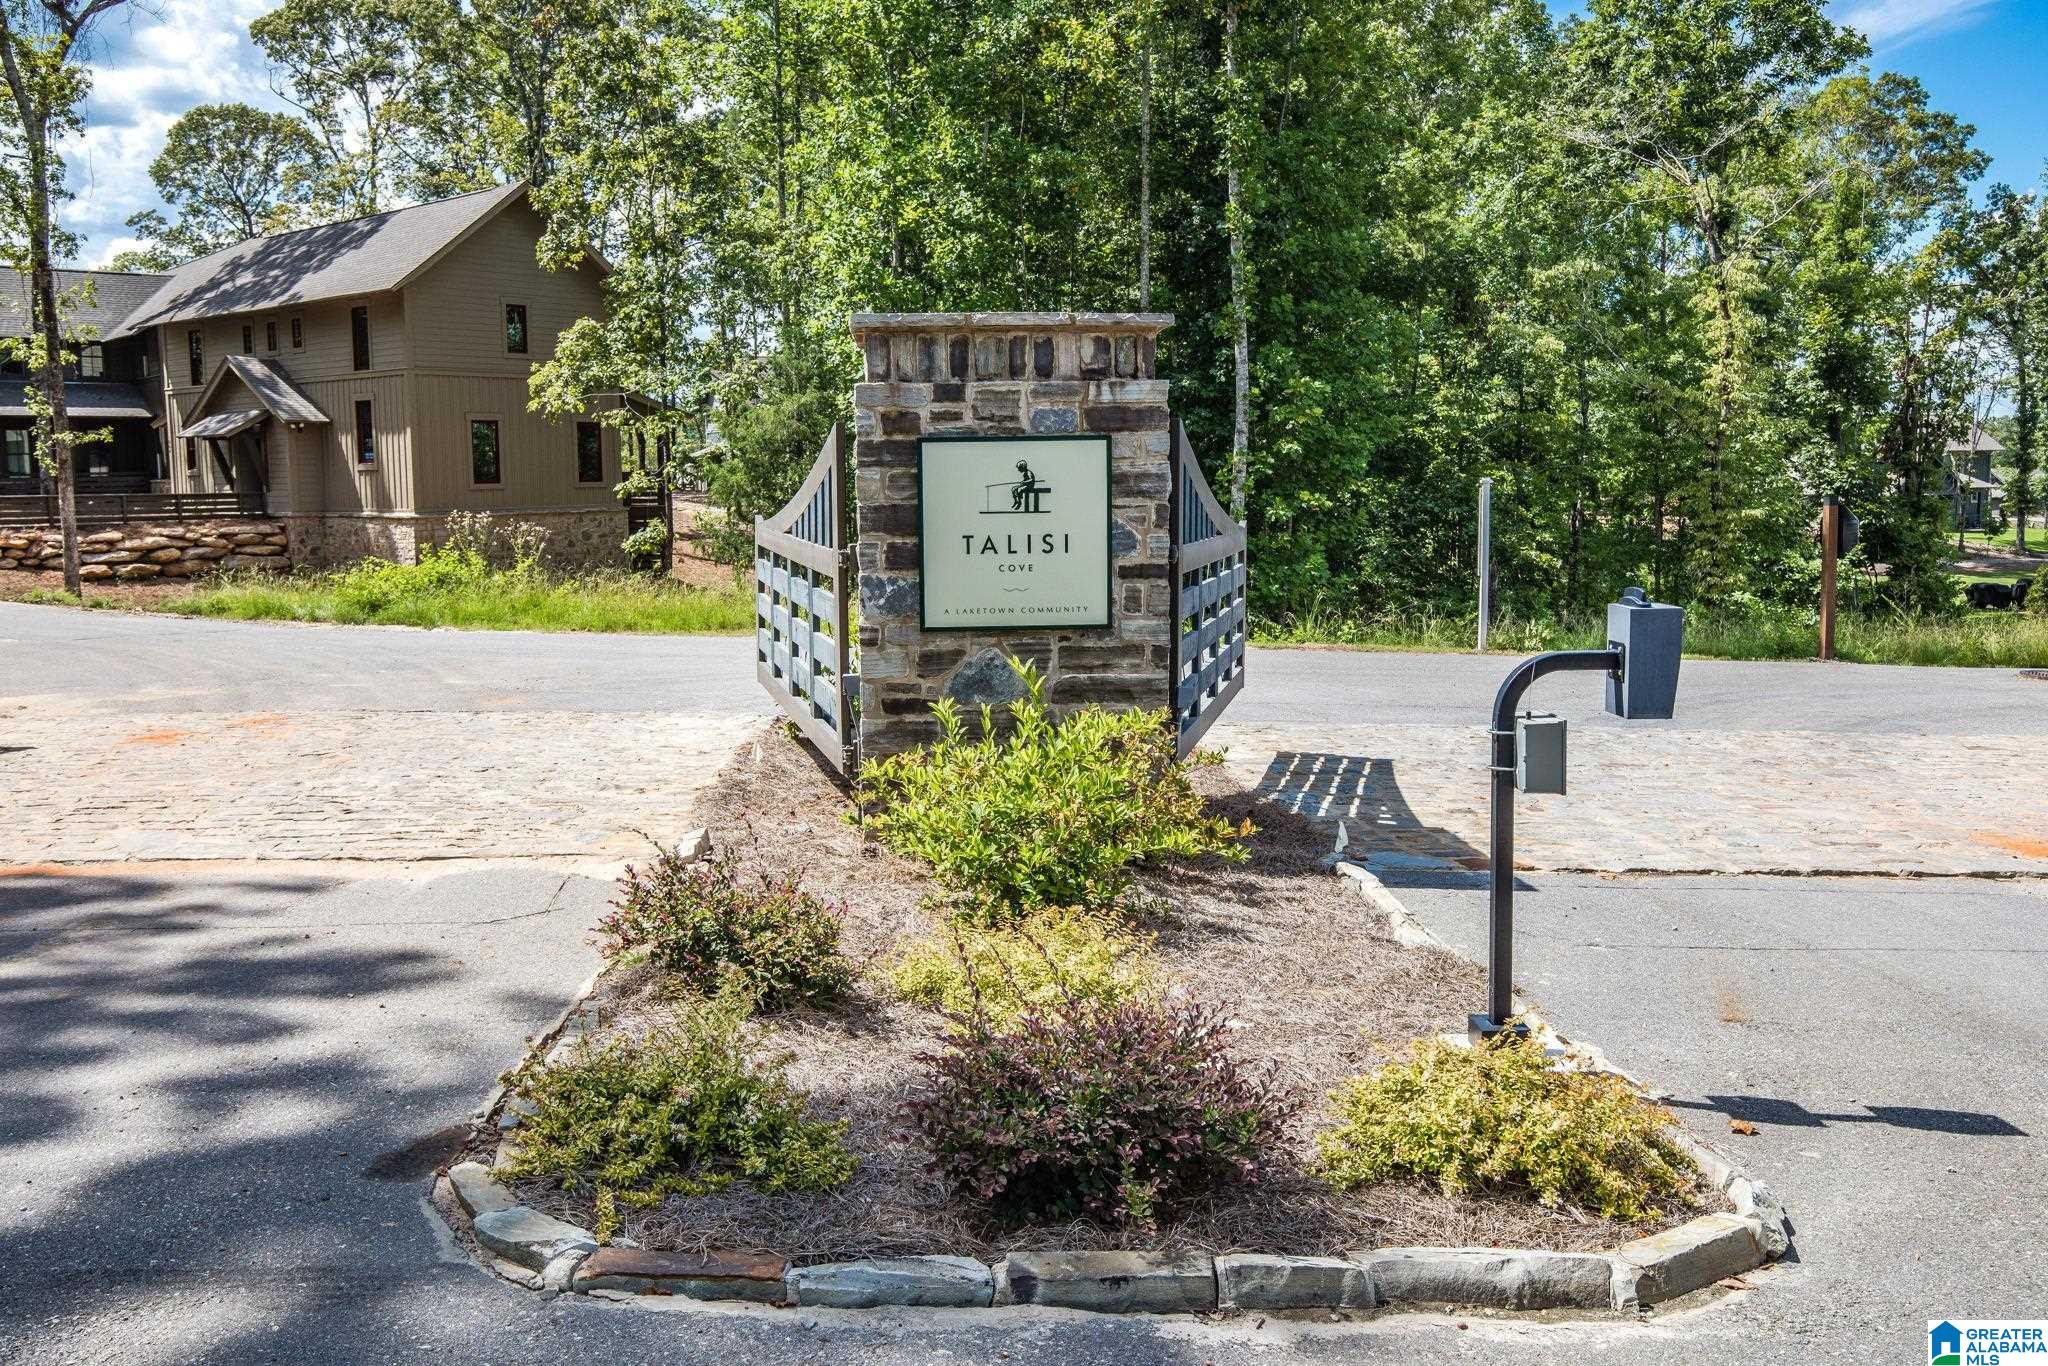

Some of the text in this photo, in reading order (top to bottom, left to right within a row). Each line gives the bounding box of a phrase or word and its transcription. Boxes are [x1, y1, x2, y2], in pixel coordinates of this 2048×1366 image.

[962, 533, 1069, 555] TALISI
[998, 564, 1034, 573] COVE
[956, 607, 1015, 615] LAKETOWN
[1020, 606, 1089, 614] COMMUNITY
